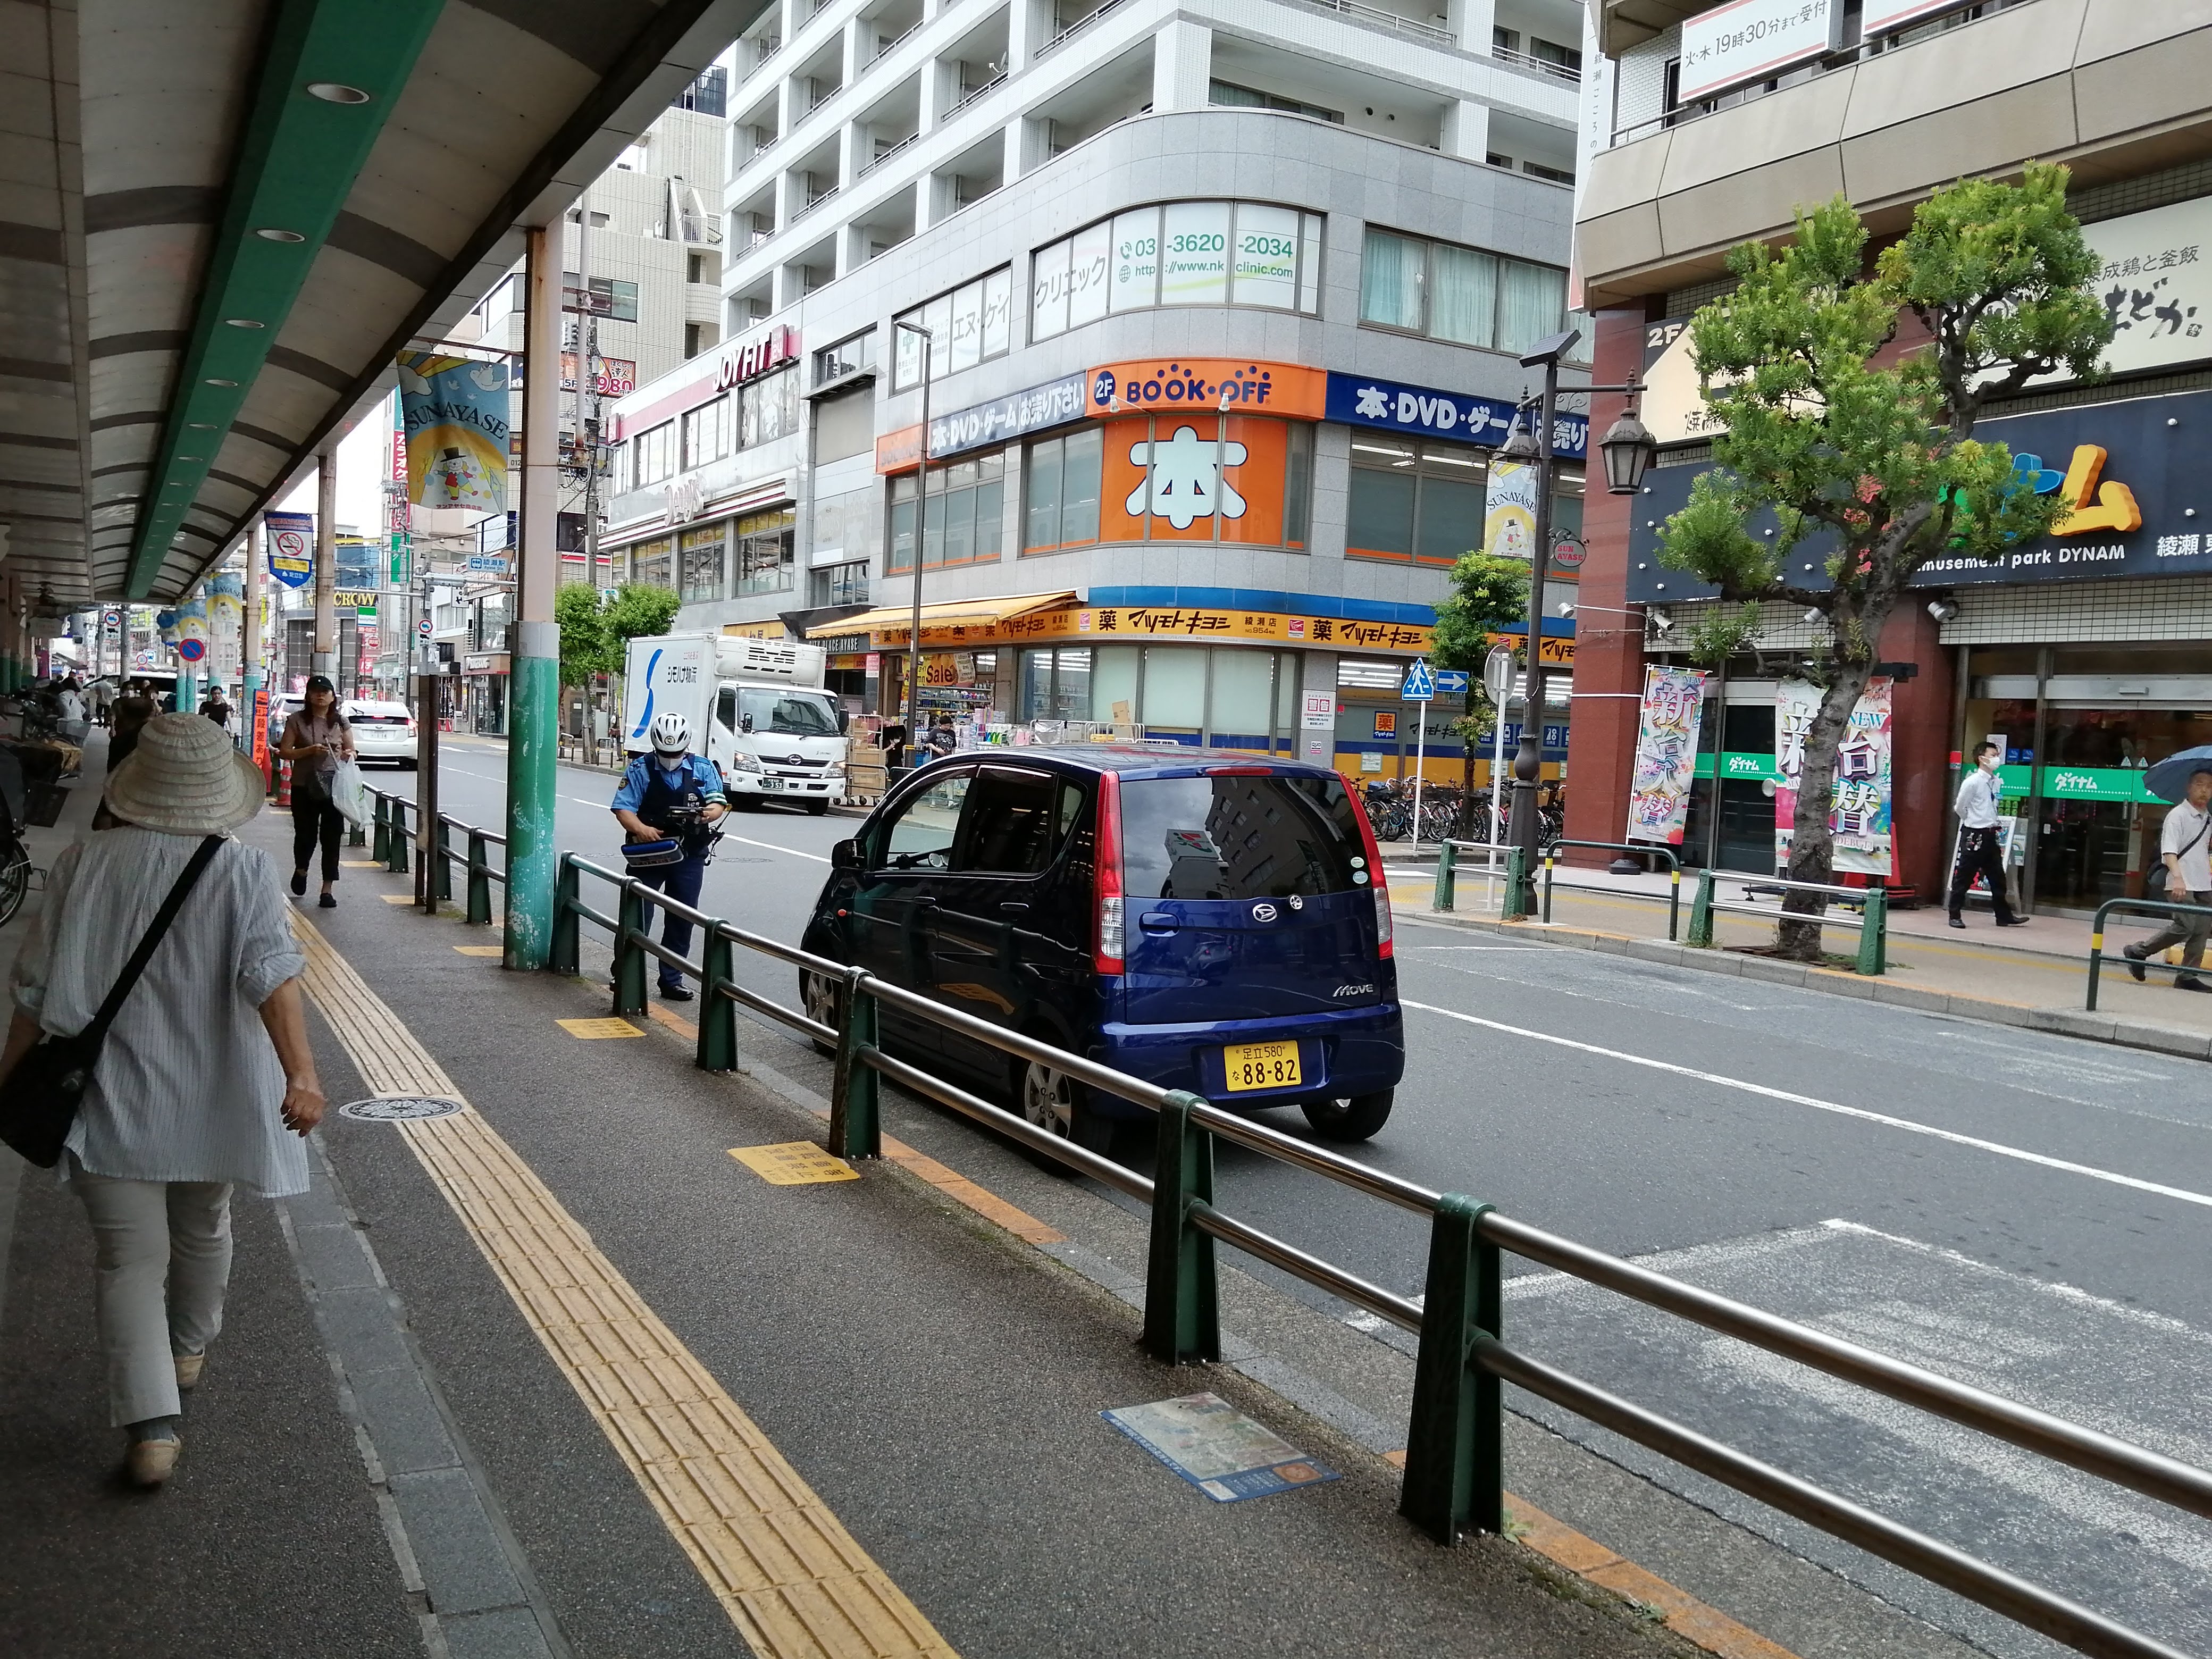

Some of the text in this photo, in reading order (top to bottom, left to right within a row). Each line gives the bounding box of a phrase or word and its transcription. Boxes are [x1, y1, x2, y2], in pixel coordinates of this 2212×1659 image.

[1036, 256, 1106, 309] クリニック
[1648, 323, 1682, 348] 2F
[611, 367, 629, 378] 達人
[712, 332, 772, 392] JOYFIT
[1096, 380, 1113, 399] 2F
[1020, 382, 1085, 426] お売り下さい
[406, 400, 509, 440] SUNAYASE
[1487, 492, 1536, 513] SUNAYASE
[2157, 534, 2199, 557] 綾瀬
[1916, 544, 2125, 572] musemet park DYNAM
[1099, 609, 1277, 633] 薬 マツモトキヨシ 綾瀬店
[1312, 619, 1422, 648] 薬 マツモトキヨシ
[840, 638, 858, 651] AYASE
[926, 665, 953, 683] Sale
[1378, 715, 1392, 730] 薬
[1848, 712, 1887, 729] NEW
[1729, 756, 1760, 772] ダイナム
[2055, 772, 2098, 790] ダイナム
[1333, 984, 1373, 998] MOVE
[1243, 1045, 1283, 1060] 足立 580
[1243, 1059, 1296, 1085] 88-82
